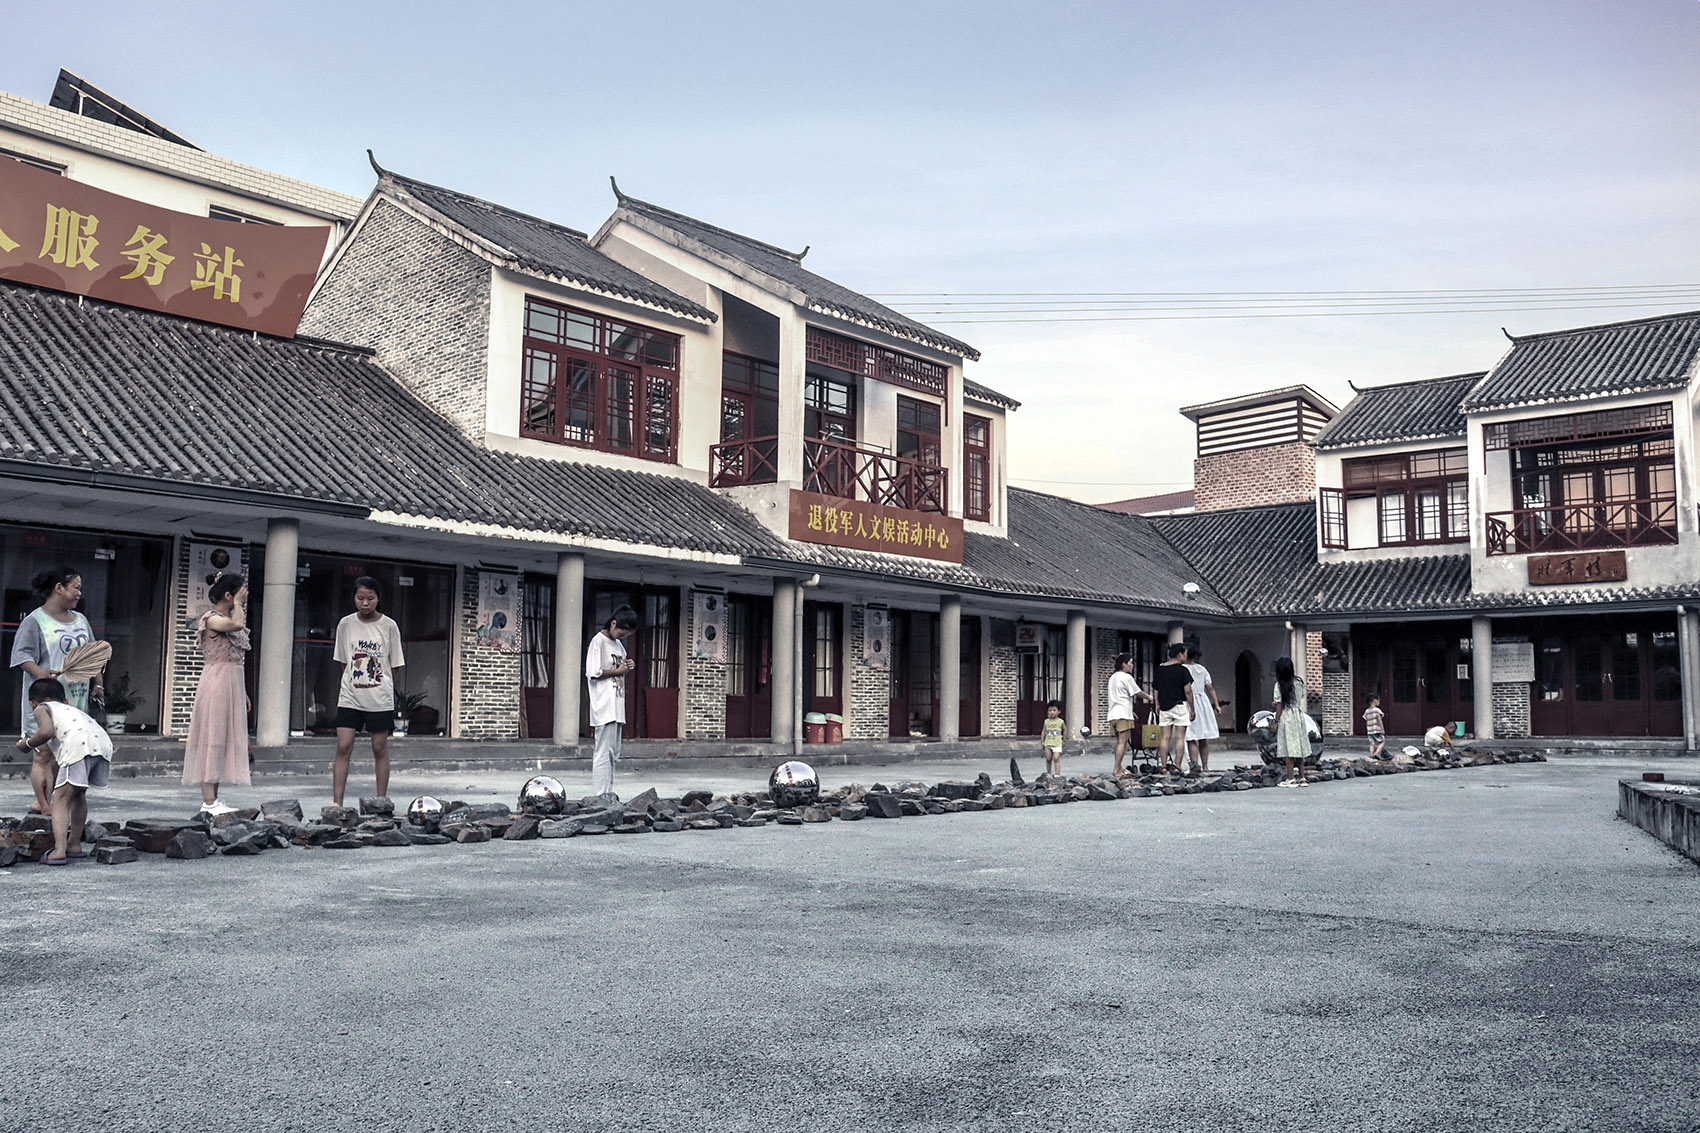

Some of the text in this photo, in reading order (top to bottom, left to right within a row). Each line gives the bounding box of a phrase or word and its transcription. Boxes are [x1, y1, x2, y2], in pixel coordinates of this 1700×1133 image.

[807, 504, 950, 549] 退役军人文娱活动中心
